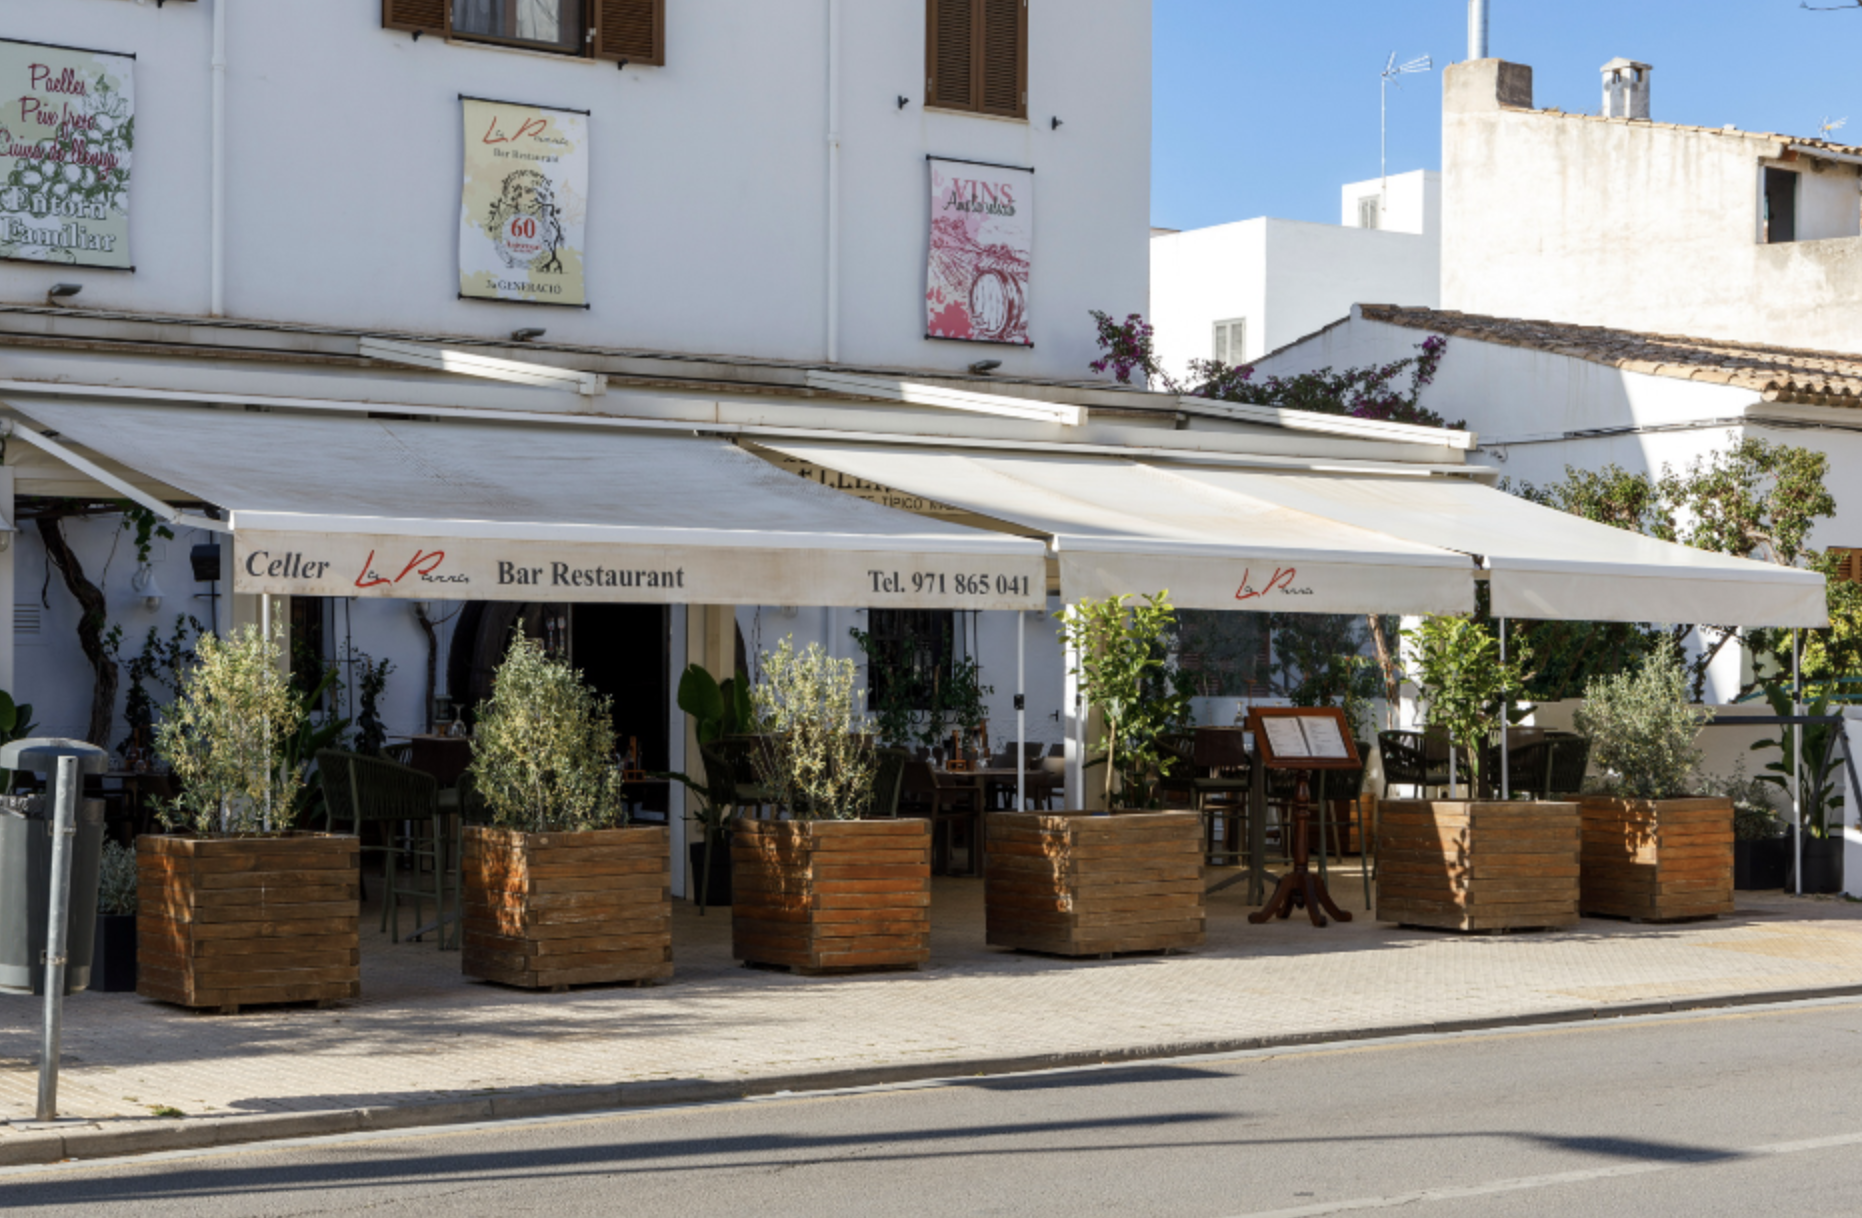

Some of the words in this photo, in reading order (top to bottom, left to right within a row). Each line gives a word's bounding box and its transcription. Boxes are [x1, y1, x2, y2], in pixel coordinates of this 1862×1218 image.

[28, 63, 87, 97] Paelles
[18, 95, 59, 126] Peix
[48, 137, 66, 163] de
[6, 185, 107, 220] Entorn
[951, 177, 1013, 208] VINS
[0, 216, 116, 252] Familiar
[511, 217, 536, 239] 60
[245, 549, 330, 579] Celler
[354, 549, 393, 589] La
[497, 560, 543, 585] Bar
[550, 561, 685, 588] Restaurant
[867, 569, 906, 593] Tel.
[911, 571, 946, 594] 971
[954, 573, 990, 595] 865
[995, 573, 1030, 596] 041
[1234, 567, 1260, 600] La
